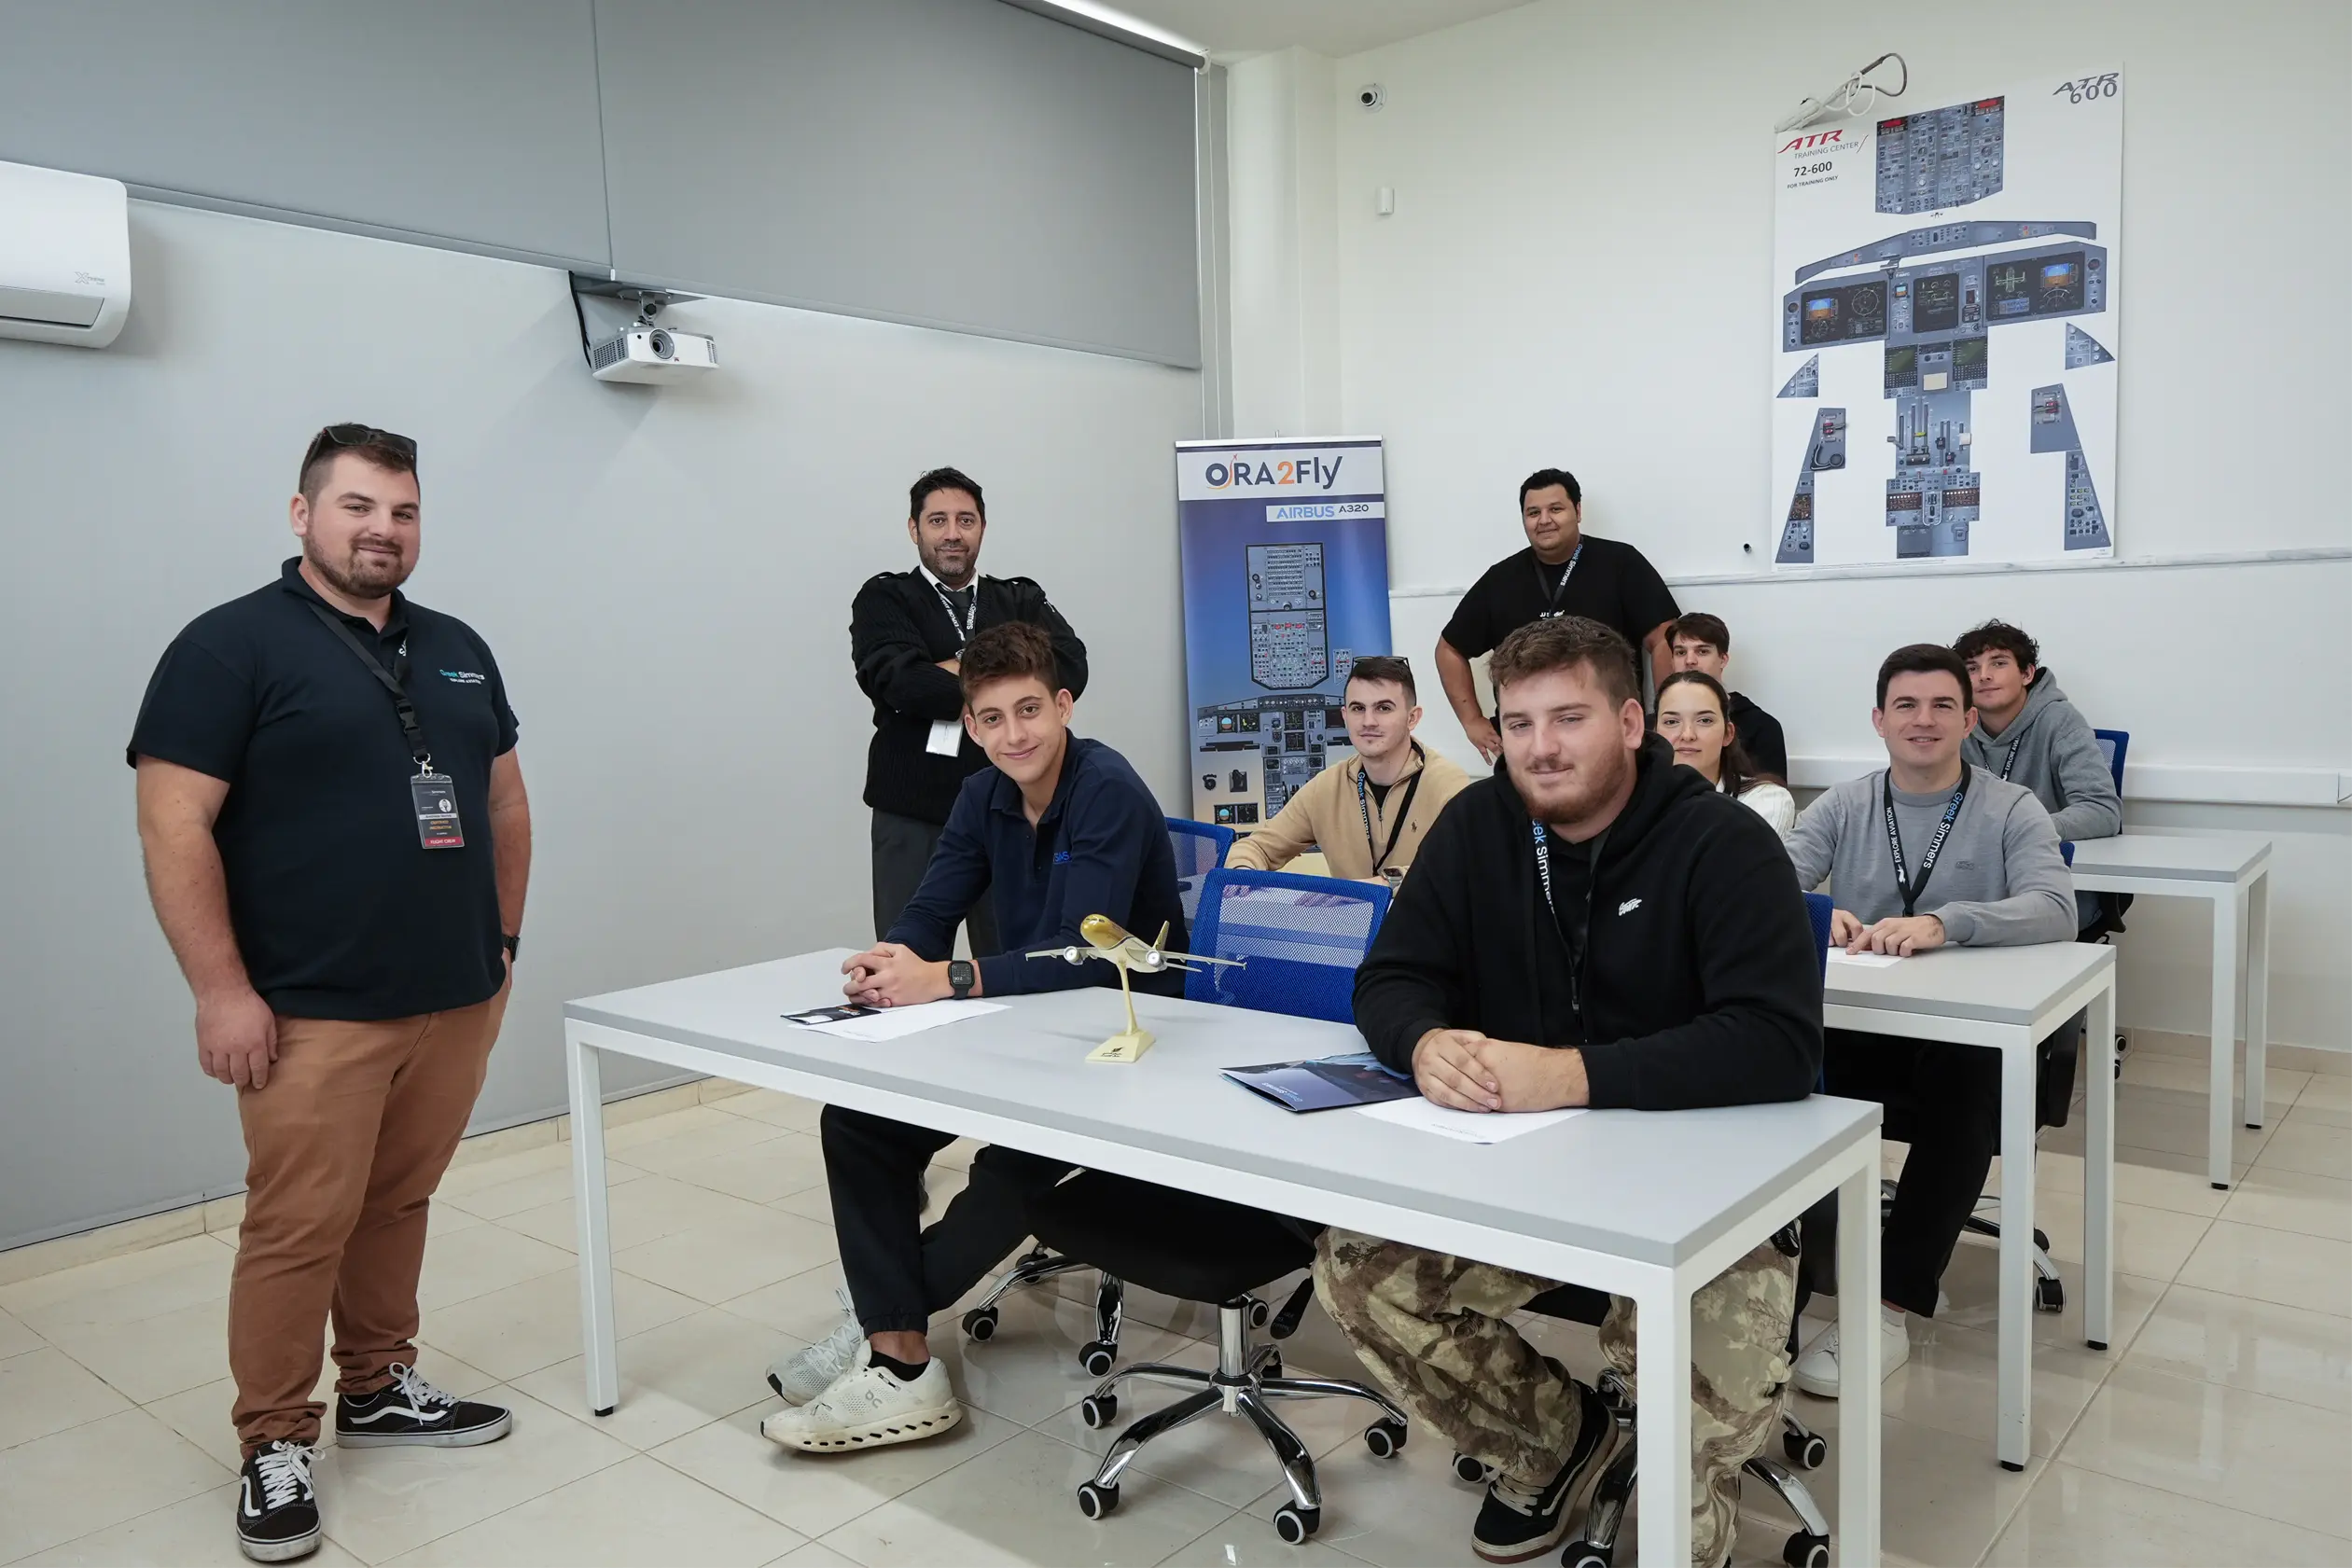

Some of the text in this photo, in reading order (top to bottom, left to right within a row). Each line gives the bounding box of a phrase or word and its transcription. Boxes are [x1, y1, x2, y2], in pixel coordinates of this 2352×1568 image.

[2053, 72, 2120, 96] ATR
[2069, 81, 2118, 104] 600
[1777, 129, 1844, 154] ATR
[1793, 141, 1859, 160] TRAINING CENTER
[1793, 160, 1832, 177] 72-600
[1799, 177, 1824, 187] TRAINING
[1824, 174, 1839, 183] ONLY
[1204, 455, 1343, 490] ORA2Fly
[1275, 504, 1370, 520] AIRBUS A320
[1559, 560, 1577, 587] Simmers
[1357, 771, 1366, 798] Greek
[1532, 817, 1547, 844] eek
[1886, 806, 1902, 864] EXPLORE AVIATION
[1923, 791, 1964, 869] Greek Simmers
